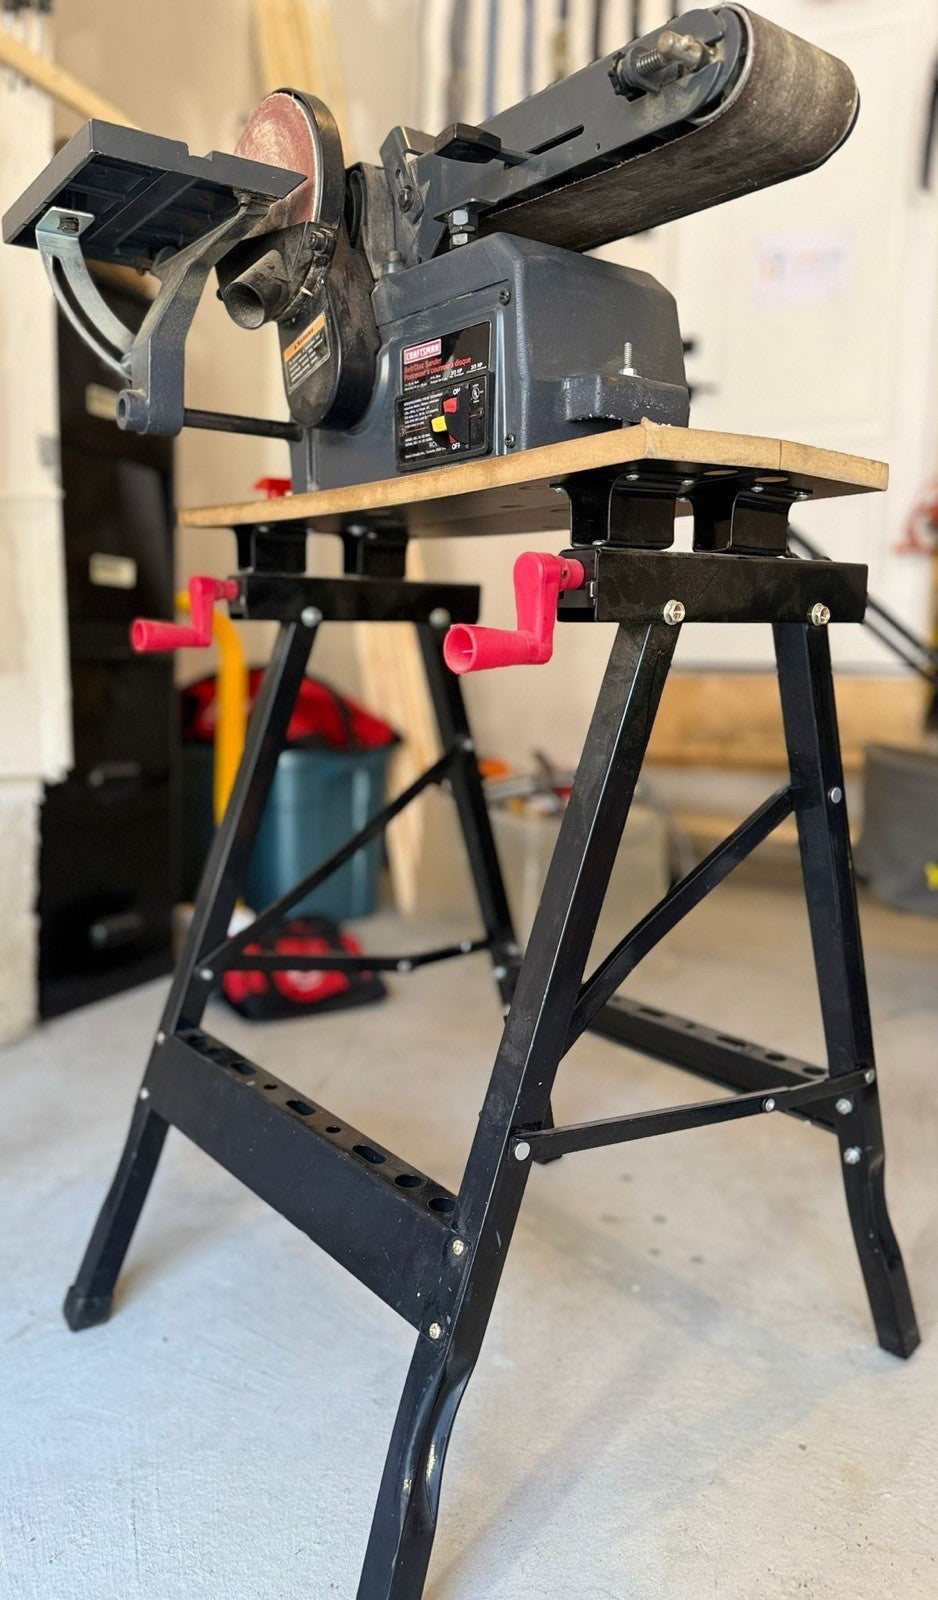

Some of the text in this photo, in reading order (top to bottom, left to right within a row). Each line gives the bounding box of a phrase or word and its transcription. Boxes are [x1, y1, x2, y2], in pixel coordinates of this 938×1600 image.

[405, 343, 440, 361] CRAFTSMAN
[425, 357, 442, 369] Sander
[454, 357, 472, 367] disque
[452, 387, 461, 395] ON
[451, 442, 461, 450] OFF
